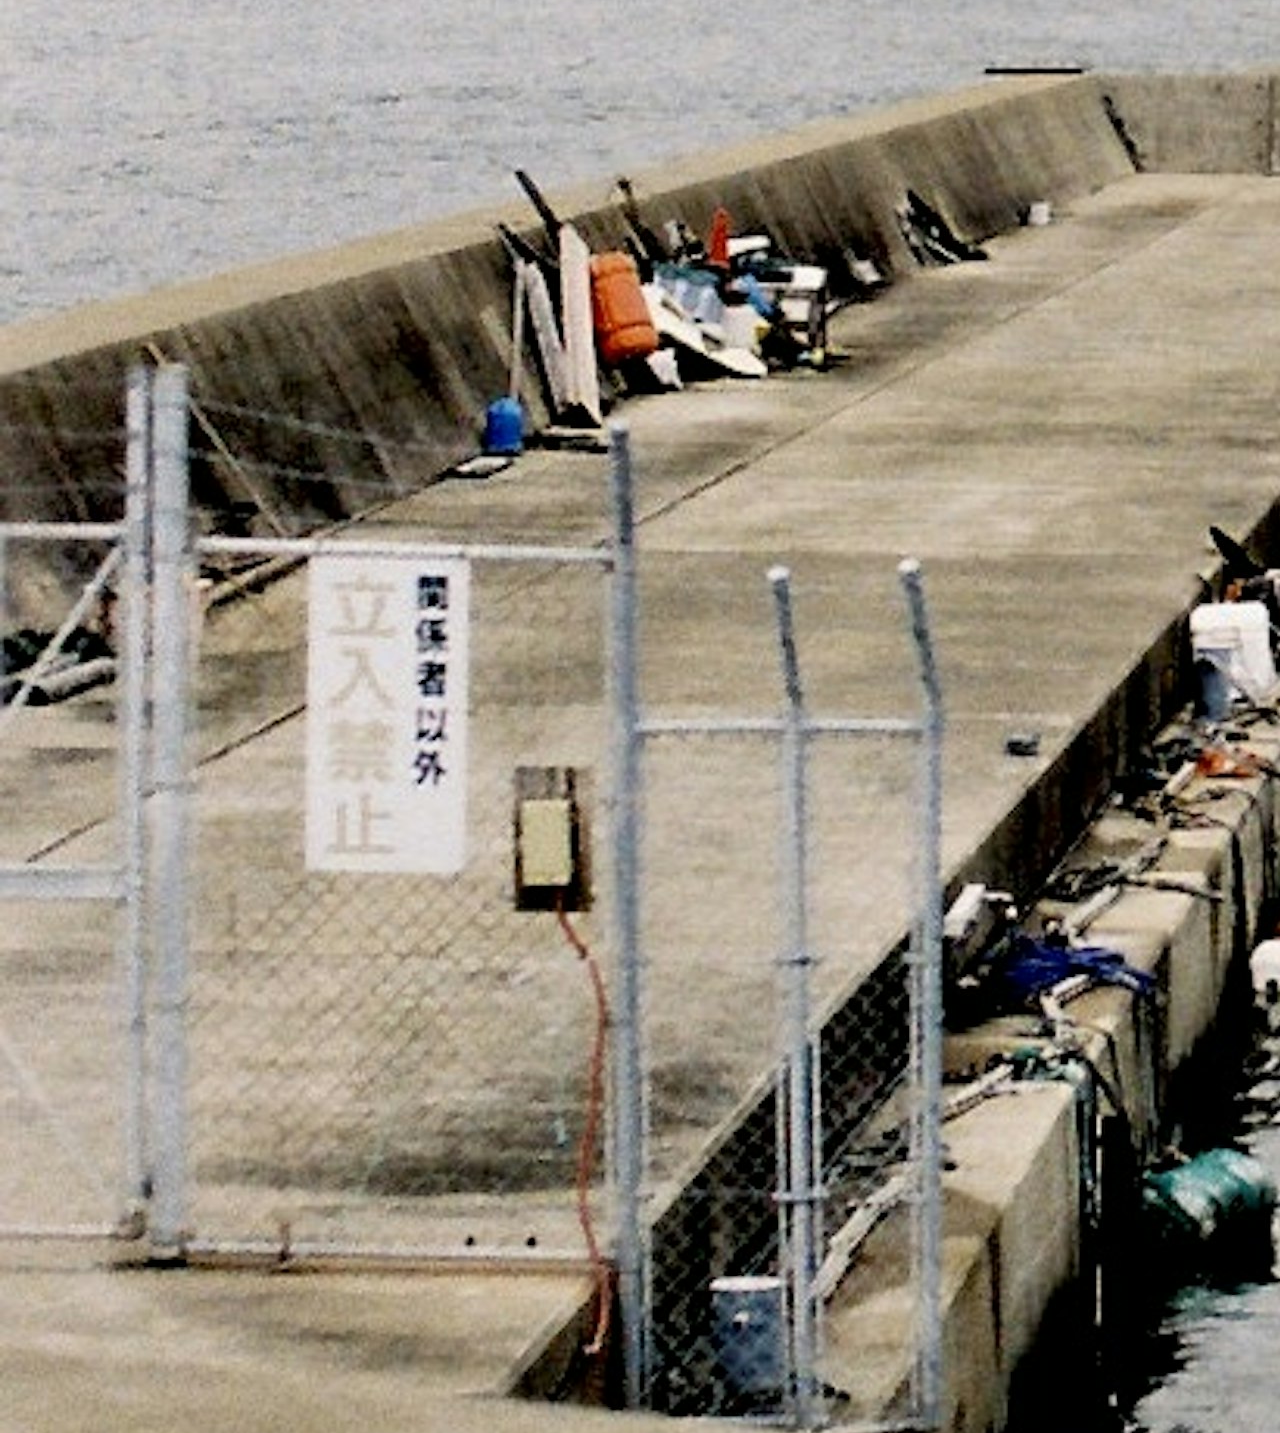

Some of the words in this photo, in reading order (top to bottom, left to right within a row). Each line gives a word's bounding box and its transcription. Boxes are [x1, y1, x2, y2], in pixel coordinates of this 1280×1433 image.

[326, 572, 396, 854] 立入禁止
[413, 575, 449, 786] 関係者以外
